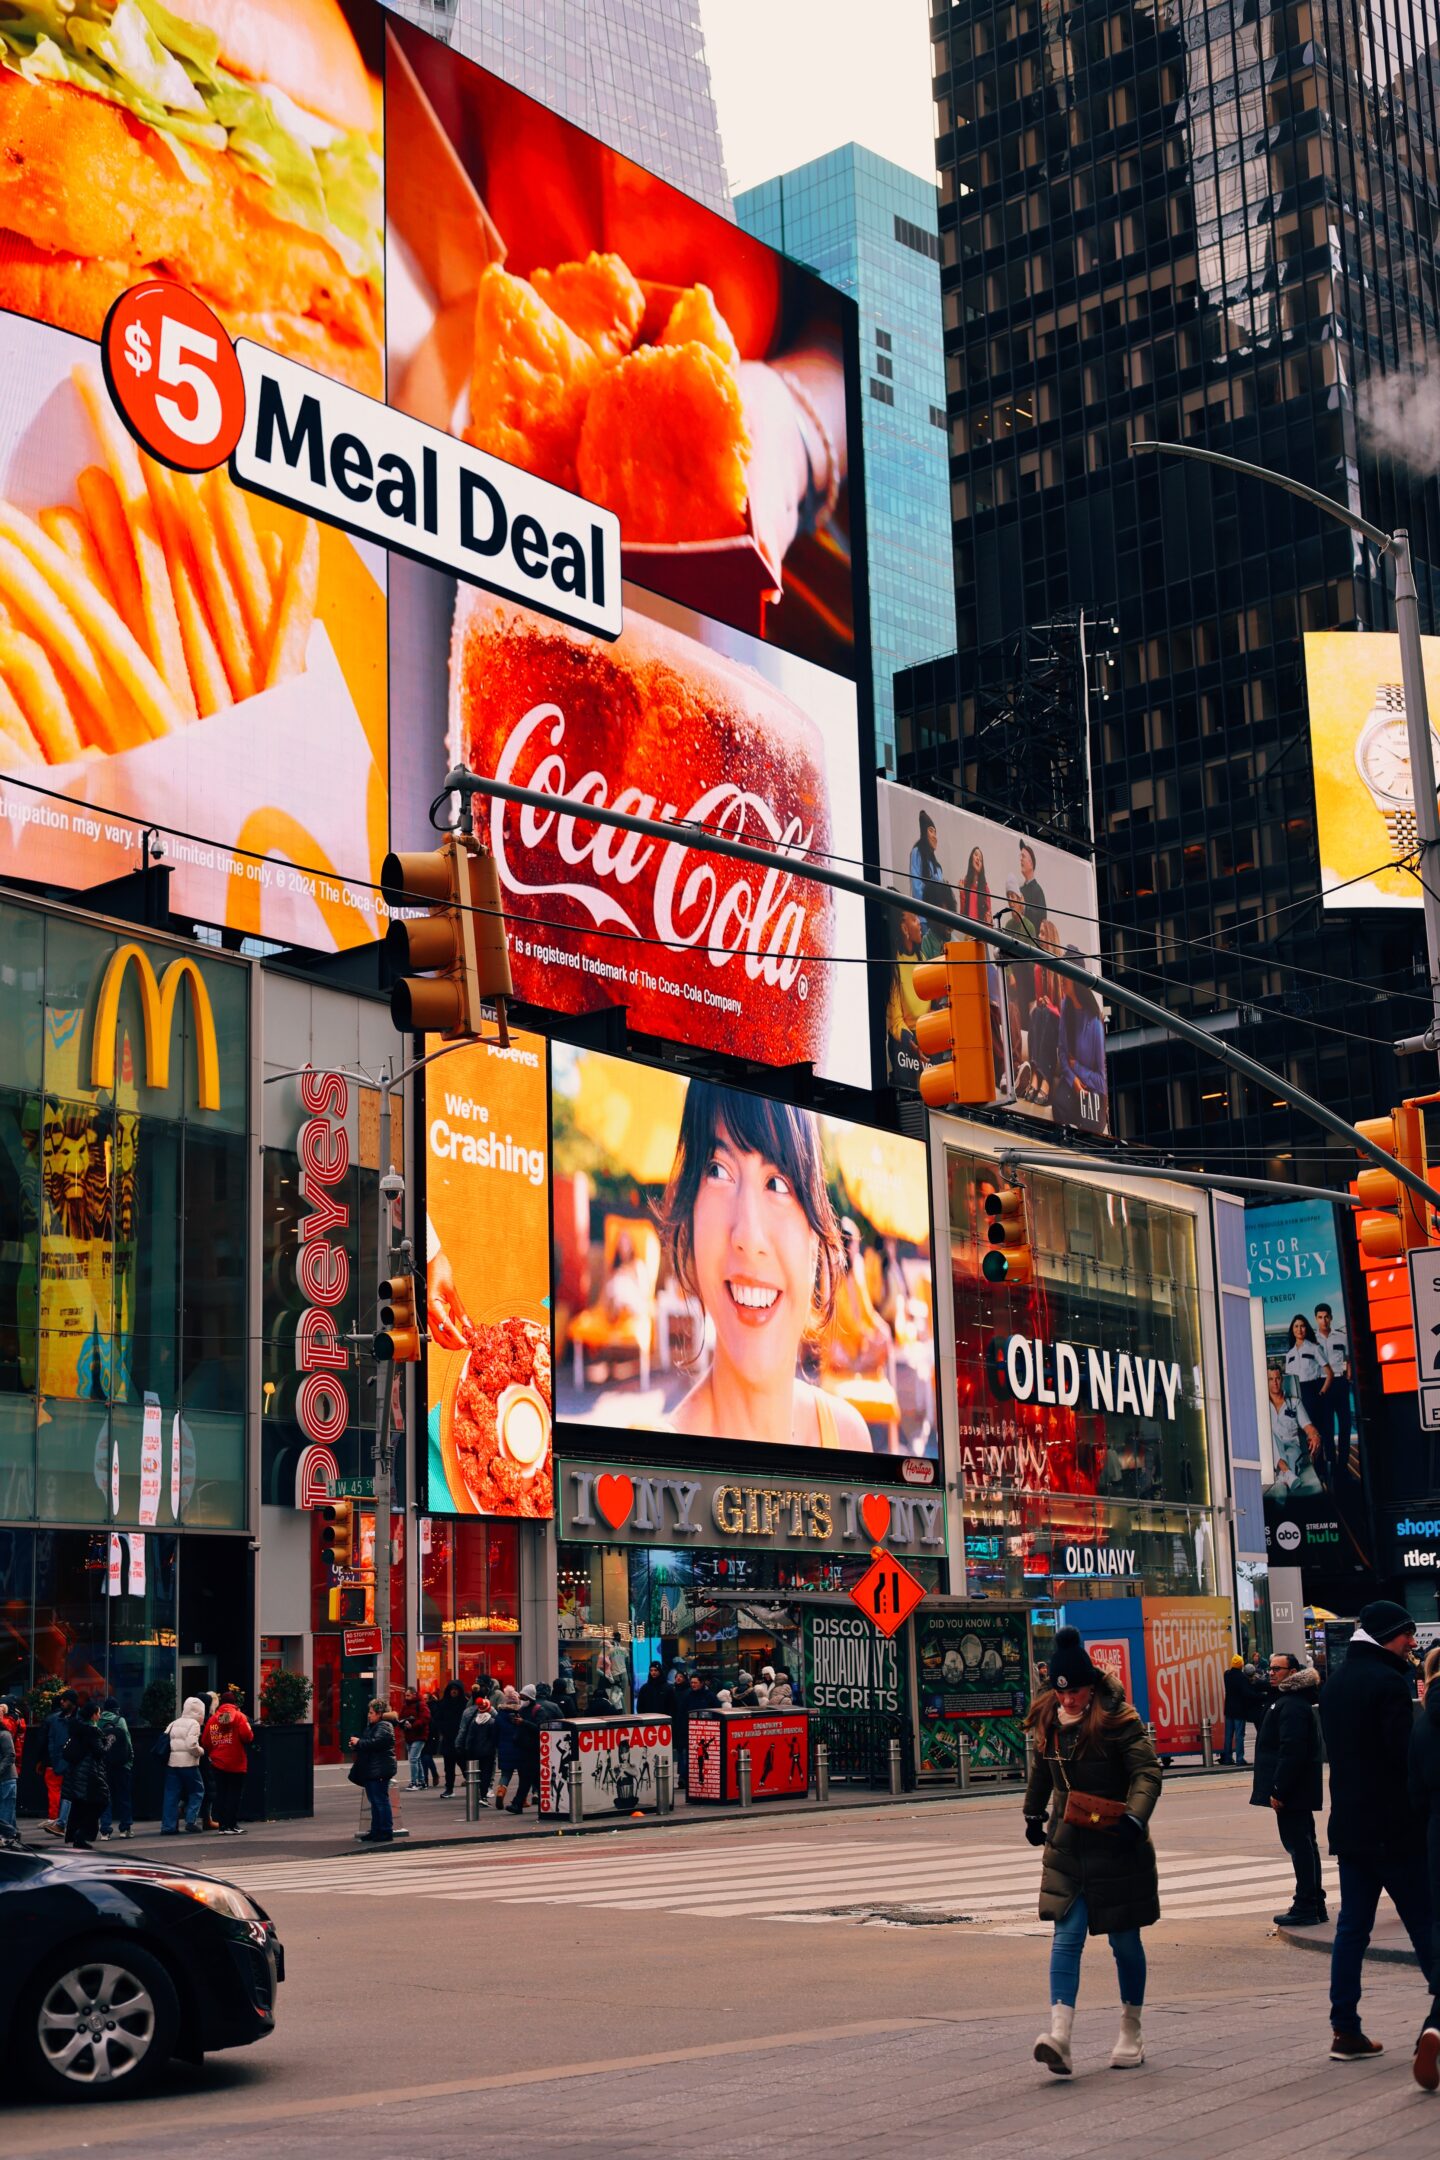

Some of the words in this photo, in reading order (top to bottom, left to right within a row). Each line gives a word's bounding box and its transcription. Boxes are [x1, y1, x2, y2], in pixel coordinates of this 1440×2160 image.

[124, 315, 223, 446] $5
[254, 374, 439, 536] Meal
[459, 464, 606, 608] Deal
[73, 816, 101, 842] may
[105, 826, 134, 850] vary.
[172, 838, 214, 869] limited
[217, 853, 243, 876] time
[247, 863, 272, 888] only.
[289, 874, 316, 897] 2024
[319, 880, 340, 903] The
[516, 936, 523, 953] is
[525, 942, 531, 956] a
[533, 943, 580, 969] registered
[582, 955, 627, 982] trademark
[629, 969, 638, 984] of
[640, 971, 656, 990] The
[658, 978, 702, 1003] Coca-Cola
[704, 990, 742, 1016] Company.
[897, 1051, 919, 1070] Give
[444, 1092, 488, 1123] We're
[1080, 1089, 1100, 1122] GAP
[430, 1119, 545, 1185] Crashing
[1250, 1237, 1299, 1257] CTOR
[1247, 1250, 1332, 1284] YSSEY
[1270, 1293, 1297, 1304] ENERGY
[1007, 1333, 1080, 1406] OLD
[1087, 1348, 1180, 1420] NAVY
[337, 1481, 346, 1494] W
[351, 1480, 363, 1494] 45
[712, 1484, 833, 1539] GIFTS
[1278, 1529, 1300, 1541] abc
[1307, 1530, 1340, 1543] hulu
[1065, 1546, 1094, 1573] OLD
[1097, 1548, 1135, 1575] NAVY
[929, 1619, 944, 1629] DID
[946, 1619, 963, 1628] YOU
[966, 1618, 991, 1628] KNOW
[1275, 1607, 1289, 1618] GAP
[353, 1630, 376, 1638] STOPPING
[1152, 1618, 1228, 1666] RECHARGE
[813, 1686, 898, 1711] SECRETS
[579, 1724, 672, 1753] CHICAGO
[540, 1731, 551, 1812] CHICAGO
